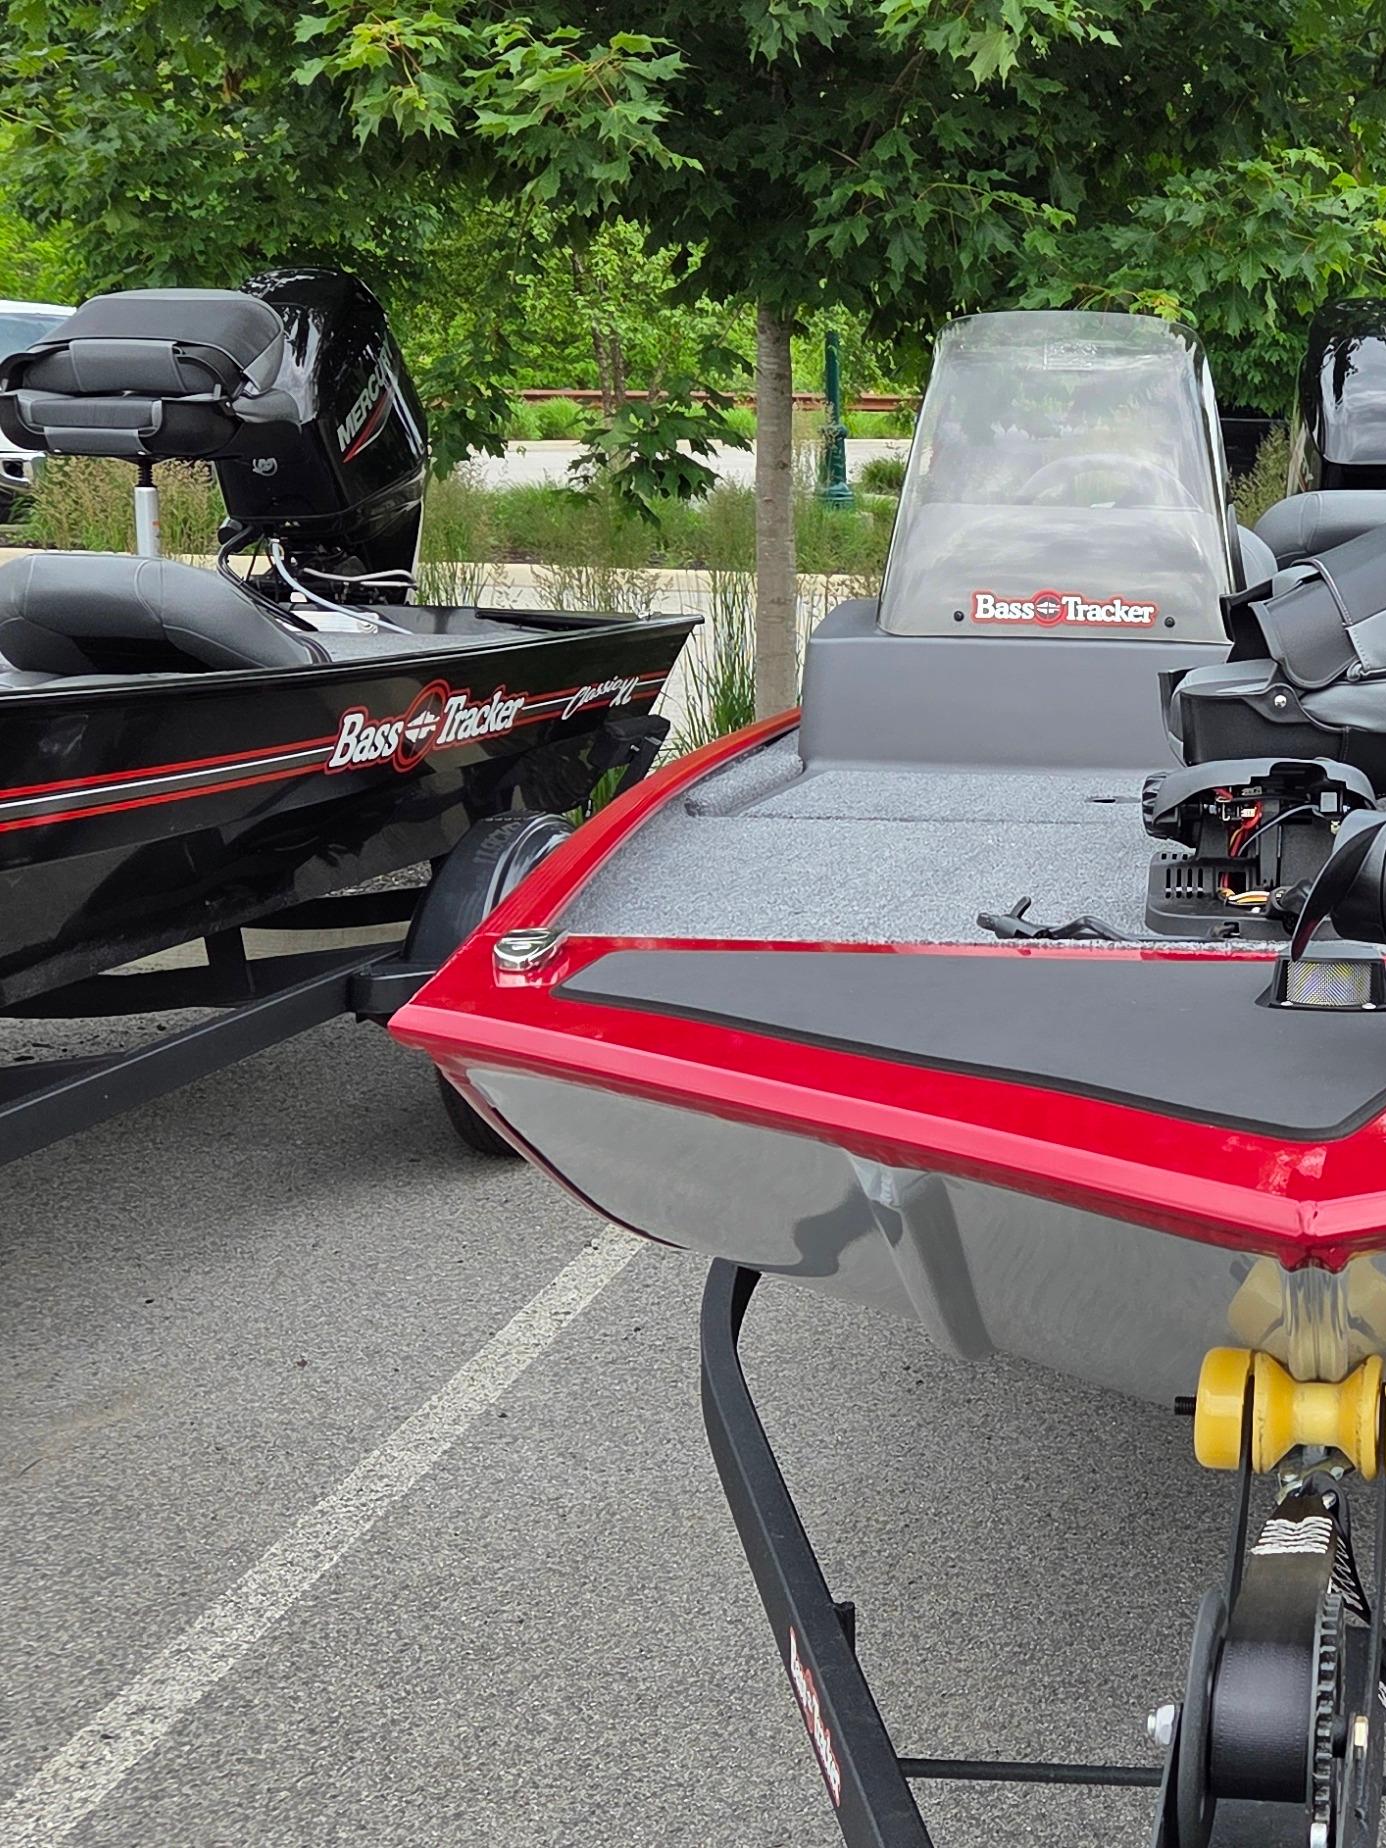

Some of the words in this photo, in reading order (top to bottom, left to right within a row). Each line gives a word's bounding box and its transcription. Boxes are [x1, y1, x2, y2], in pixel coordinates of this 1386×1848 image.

[975, 594, 1035, 619] Bass
[1061, 596, 1155, 624] Tracker
[329, 713, 404, 767] Bass
[436, 691, 524, 744] Tracker
